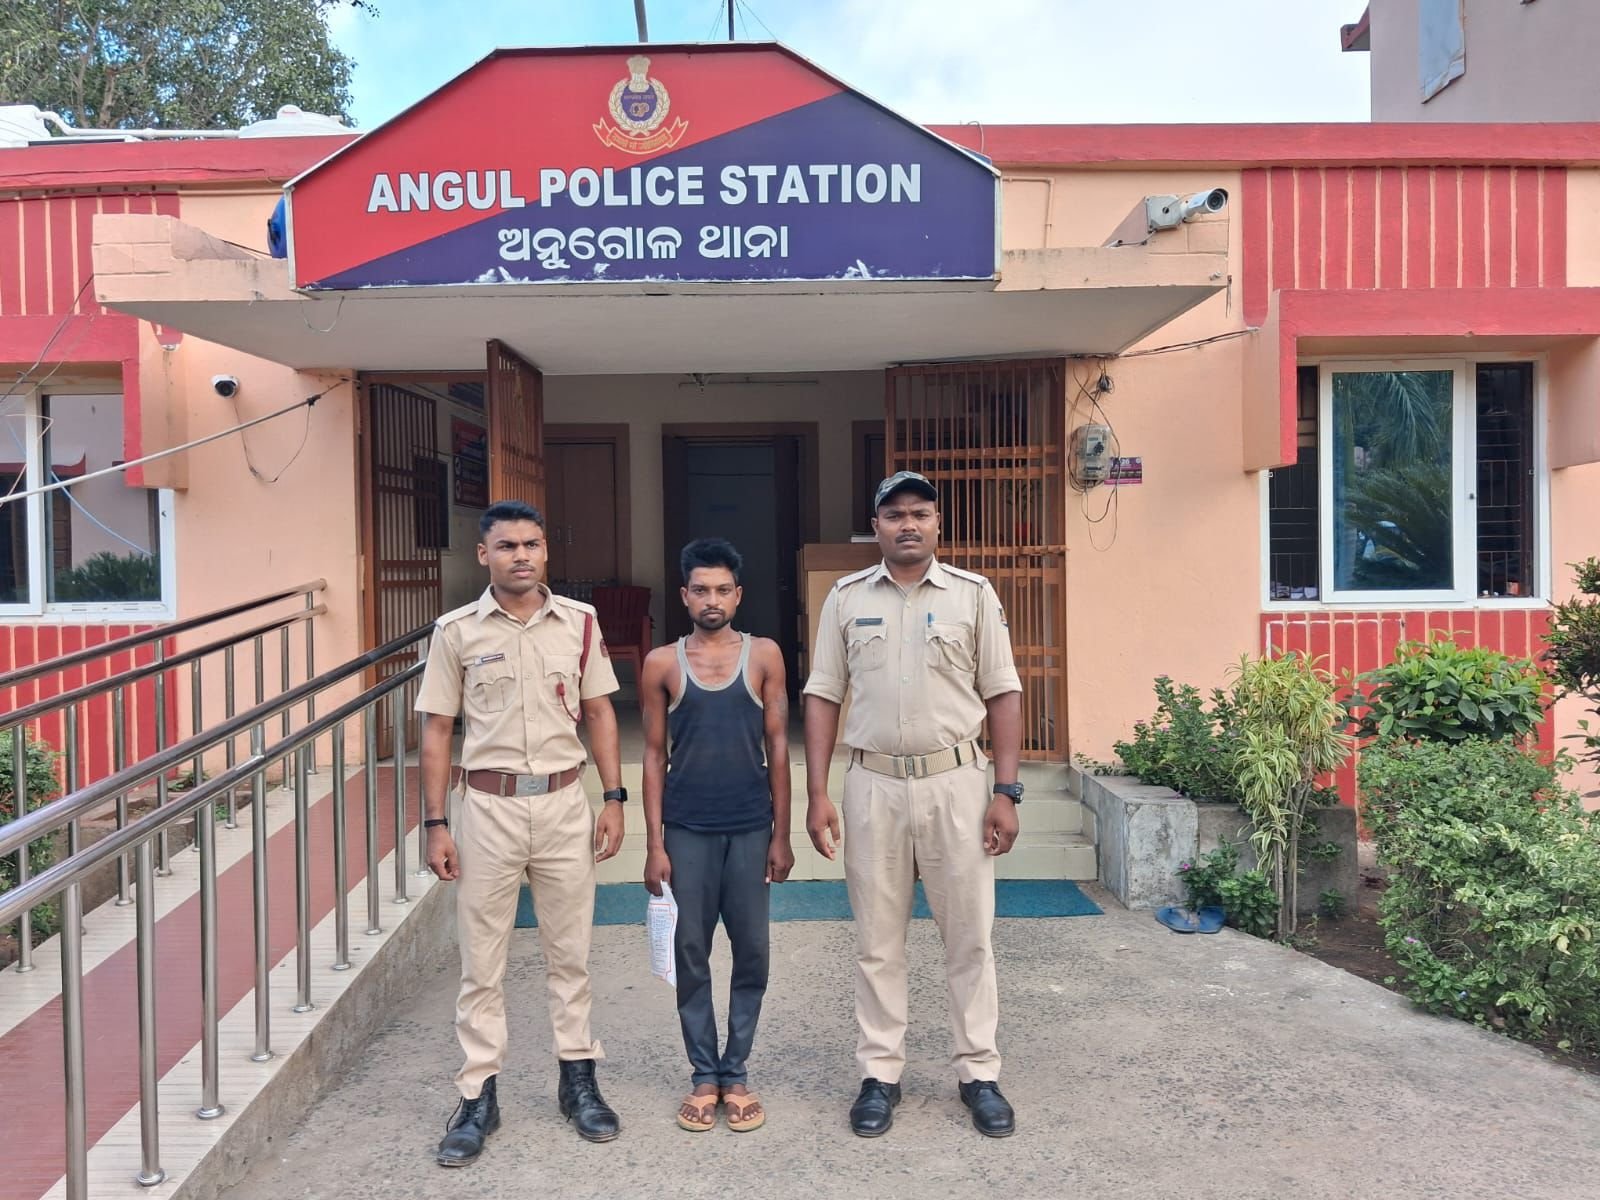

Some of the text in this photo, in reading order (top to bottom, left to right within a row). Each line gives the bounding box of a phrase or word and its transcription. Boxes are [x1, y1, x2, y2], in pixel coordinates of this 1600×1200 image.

[367, 163, 921, 213] ANGUL POLICE STATION
[497, 225, 788, 270] ଅନୁଗୋଳ ଥାନା
